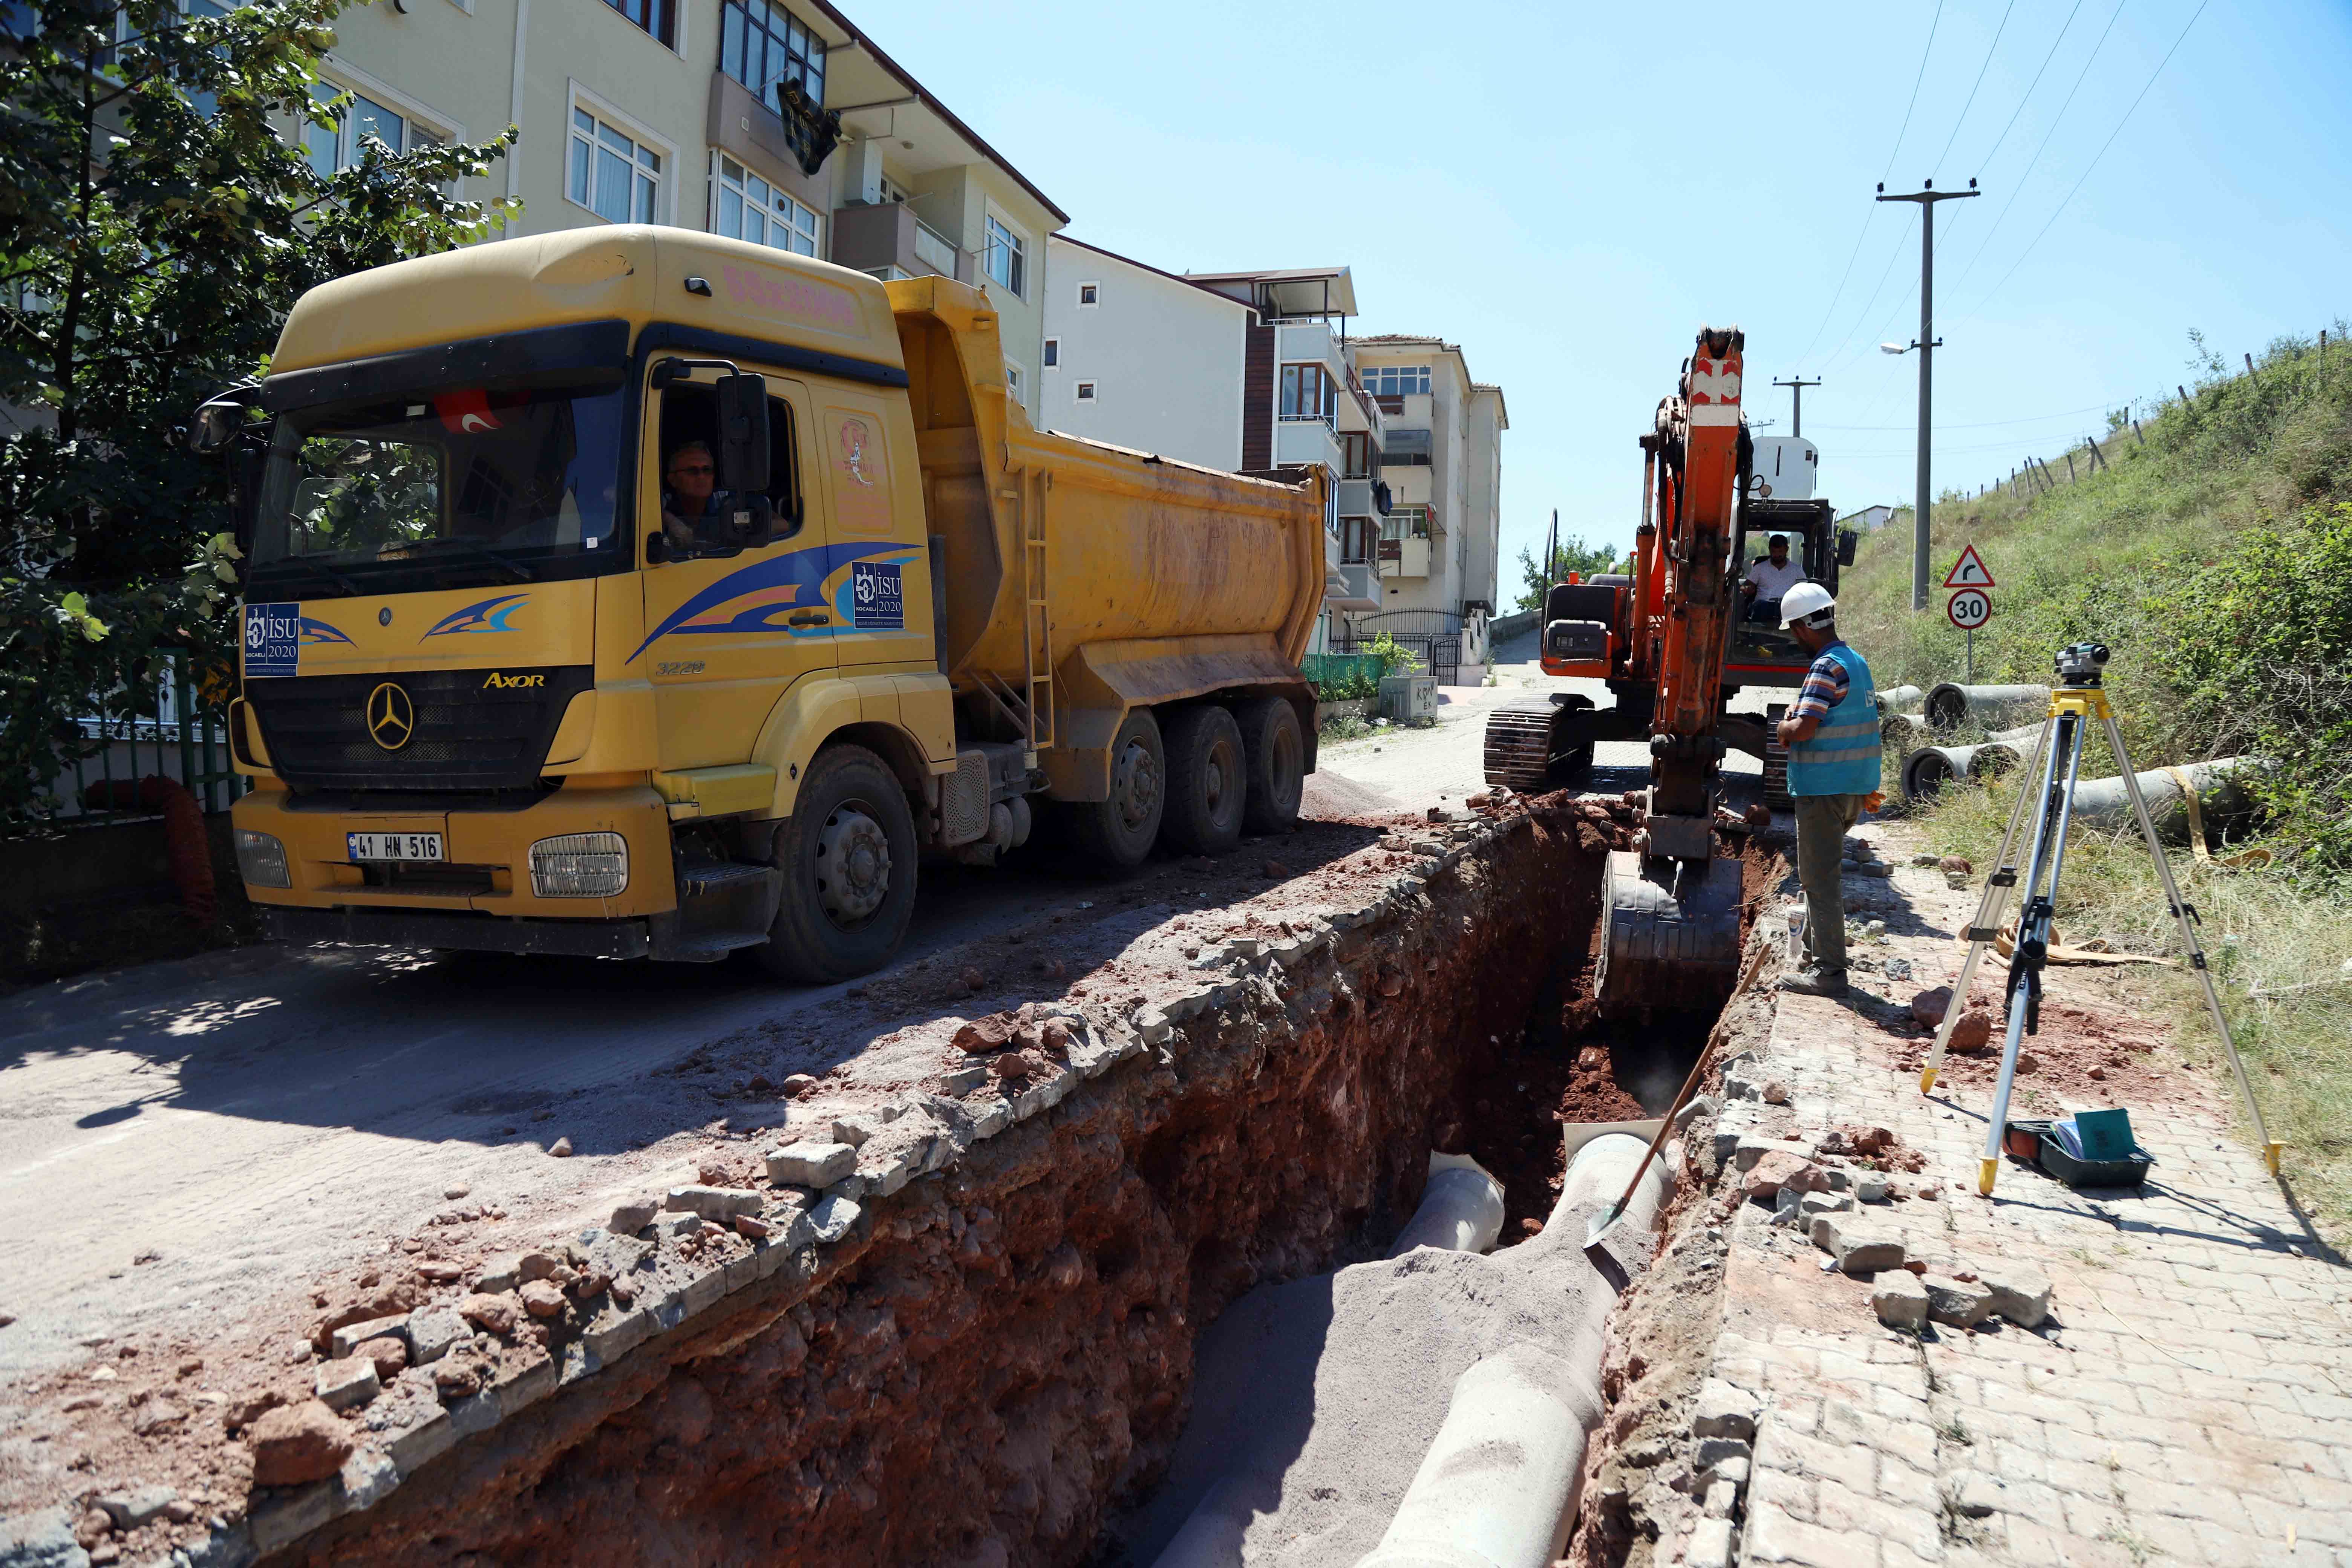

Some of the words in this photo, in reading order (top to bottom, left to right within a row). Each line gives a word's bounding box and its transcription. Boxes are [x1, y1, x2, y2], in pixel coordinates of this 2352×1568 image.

[877, 572, 900, 595] İSU
[879, 601, 901, 612] 2020
[1955, 600, 1983, 619] 30
[268, 613, 298, 639] İSU
[268, 646, 296, 657] 2020
[360, 836, 373, 857] 41
[385, 836, 401, 857] HN
[410, 836, 437, 858] 516
